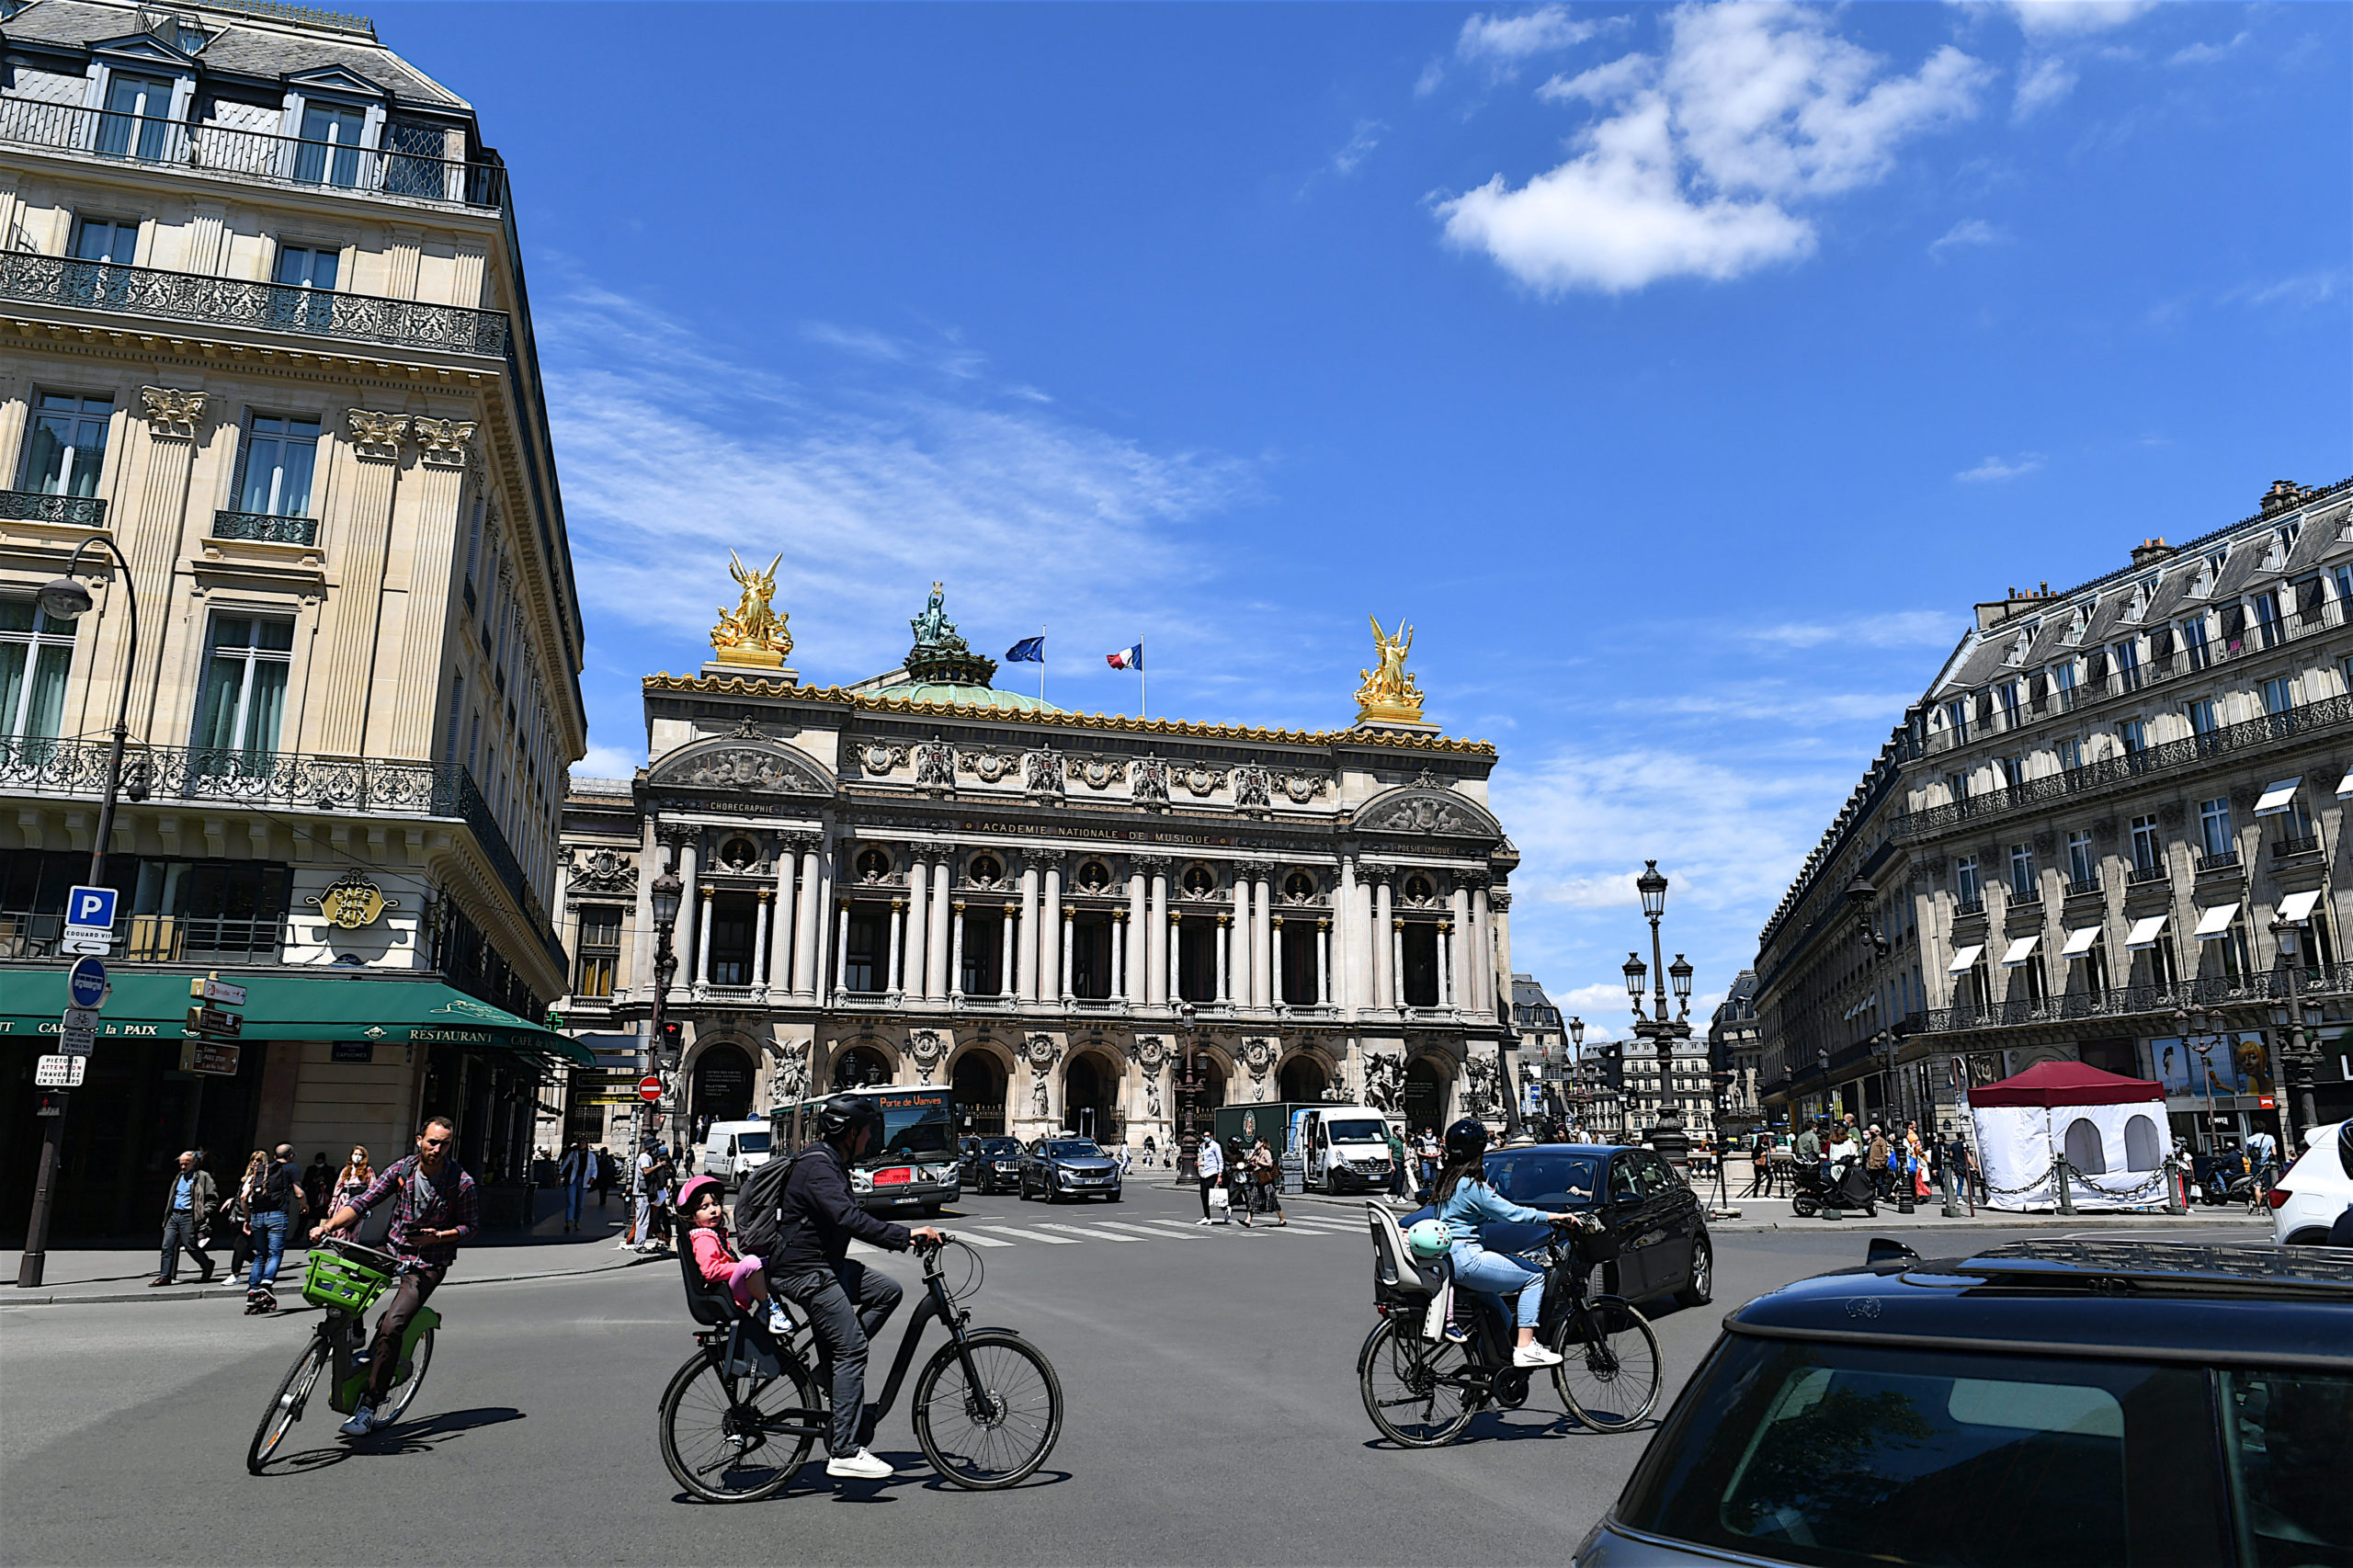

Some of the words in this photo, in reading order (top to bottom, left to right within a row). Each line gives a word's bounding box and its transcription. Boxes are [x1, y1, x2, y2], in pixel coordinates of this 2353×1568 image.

[710, 801, 774, 813] CHOREGRAPHIE
[983, 823, 1047, 835] ACADEMIE
[1058, 827, 1119, 839] NATIONALE
[1129, 831, 1144, 840] DE
[1155, 833, 1210, 845] MUSIQUE
[1397, 845, 1421, 853] POESIE
[1425, 846, 1450, 854] LYRIQUE
[80, 895, 102, 919] P
[341, 900, 352, 908] de
[355, 900, 363, 908] la
[335, 907, 368, 920] PAIX
[66, 930, 99, 938] EDOUARD
[38, 1022, 68, 1033] CAF
[105, 1024, 117, 1035] la
[123, 1025, 157, 1036] PAIX
[409, 1028, 494, 1043] RESTAURANT
[880, 1096, 901, 1108] Porte
[903, 1098, 912, 1107] de
[913, 1095, 942, 1106] Vanves
[2207, 1116, 2229, 1126] CMPER
